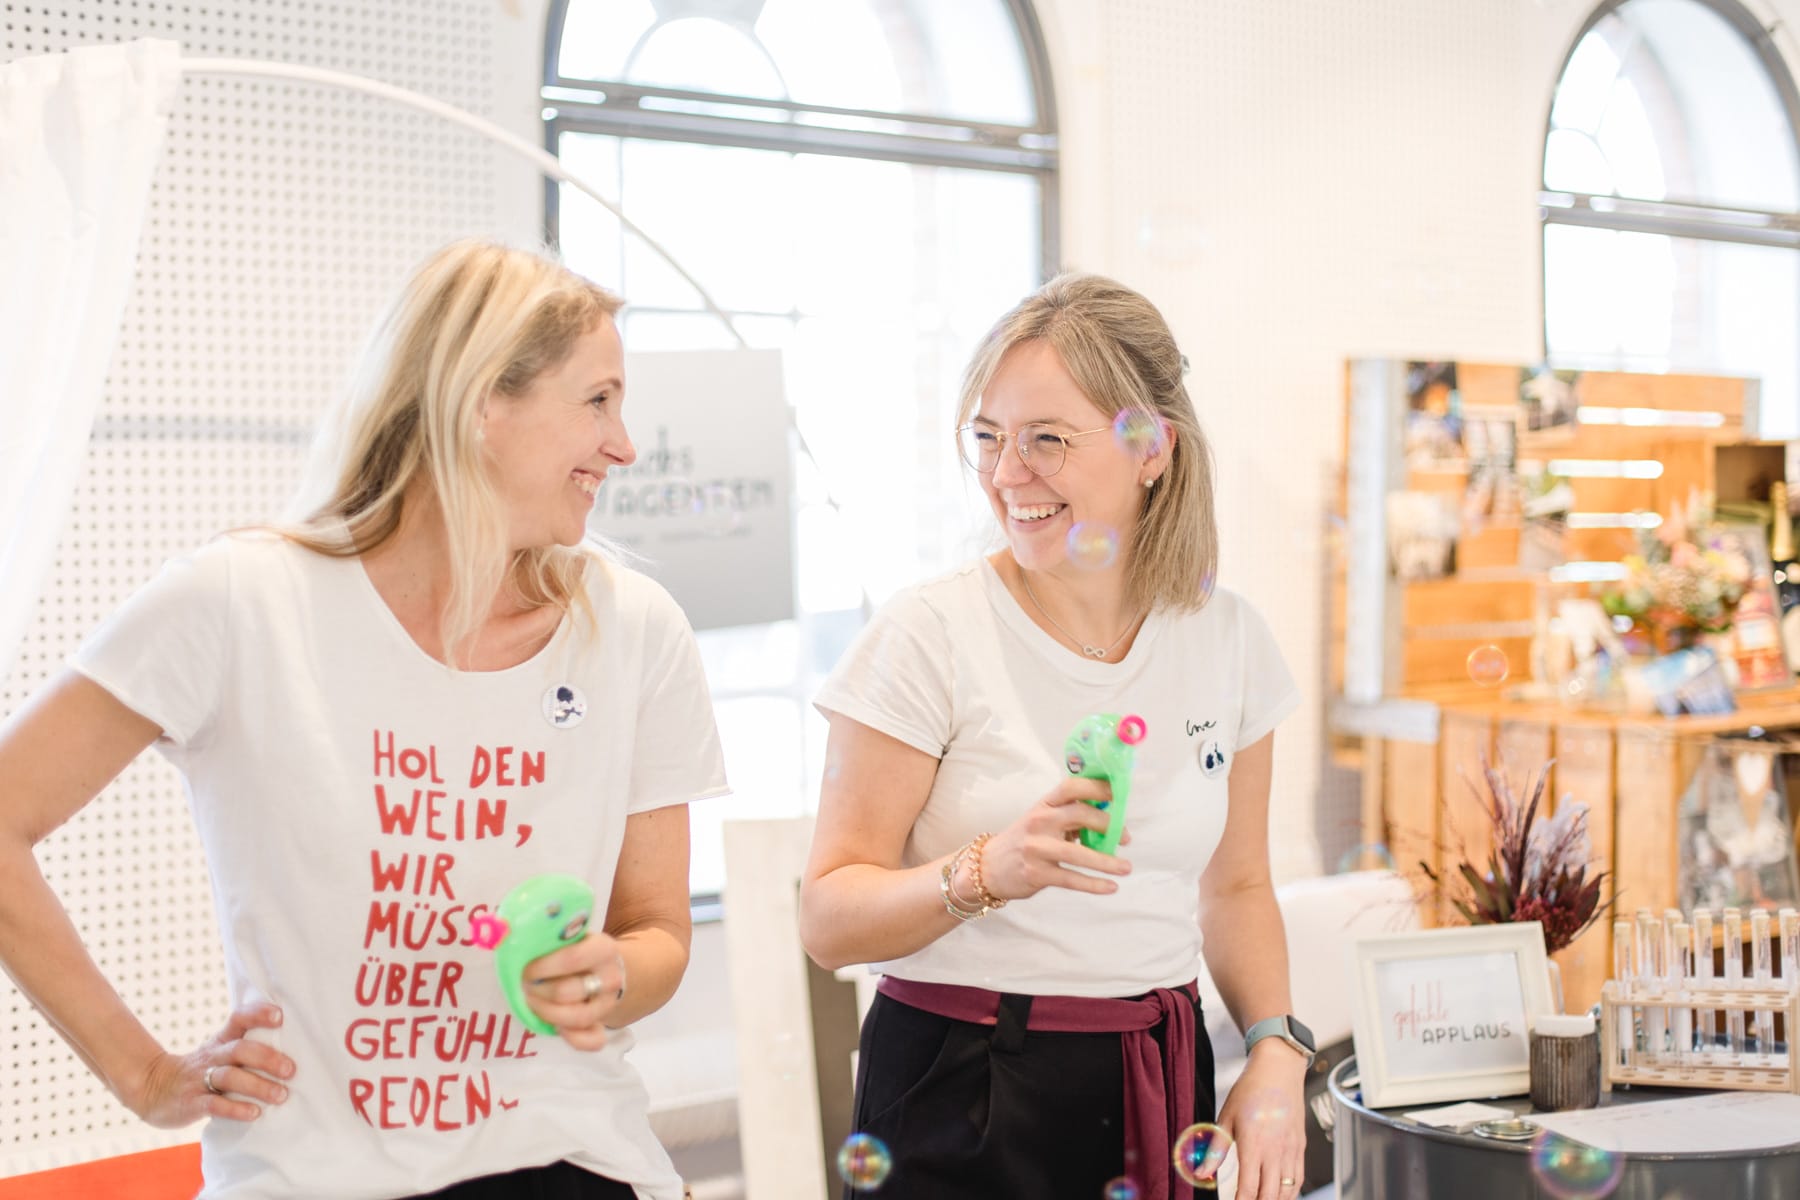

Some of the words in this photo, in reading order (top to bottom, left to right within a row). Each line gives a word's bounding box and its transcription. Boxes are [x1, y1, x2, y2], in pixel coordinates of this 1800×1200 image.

[469, 744, 545, 789] DEN
[374, 783, 533, 847] WEIN,
[371, 849, 456, 901] WIR
[363, 900, 500, 951] MÜSS
[355, 955, 464, 1009] ÜBER
[344, 1010, 539, 1063] GEFÜHLE
[1421, 1021, 1512, 1045] APPLAUS
